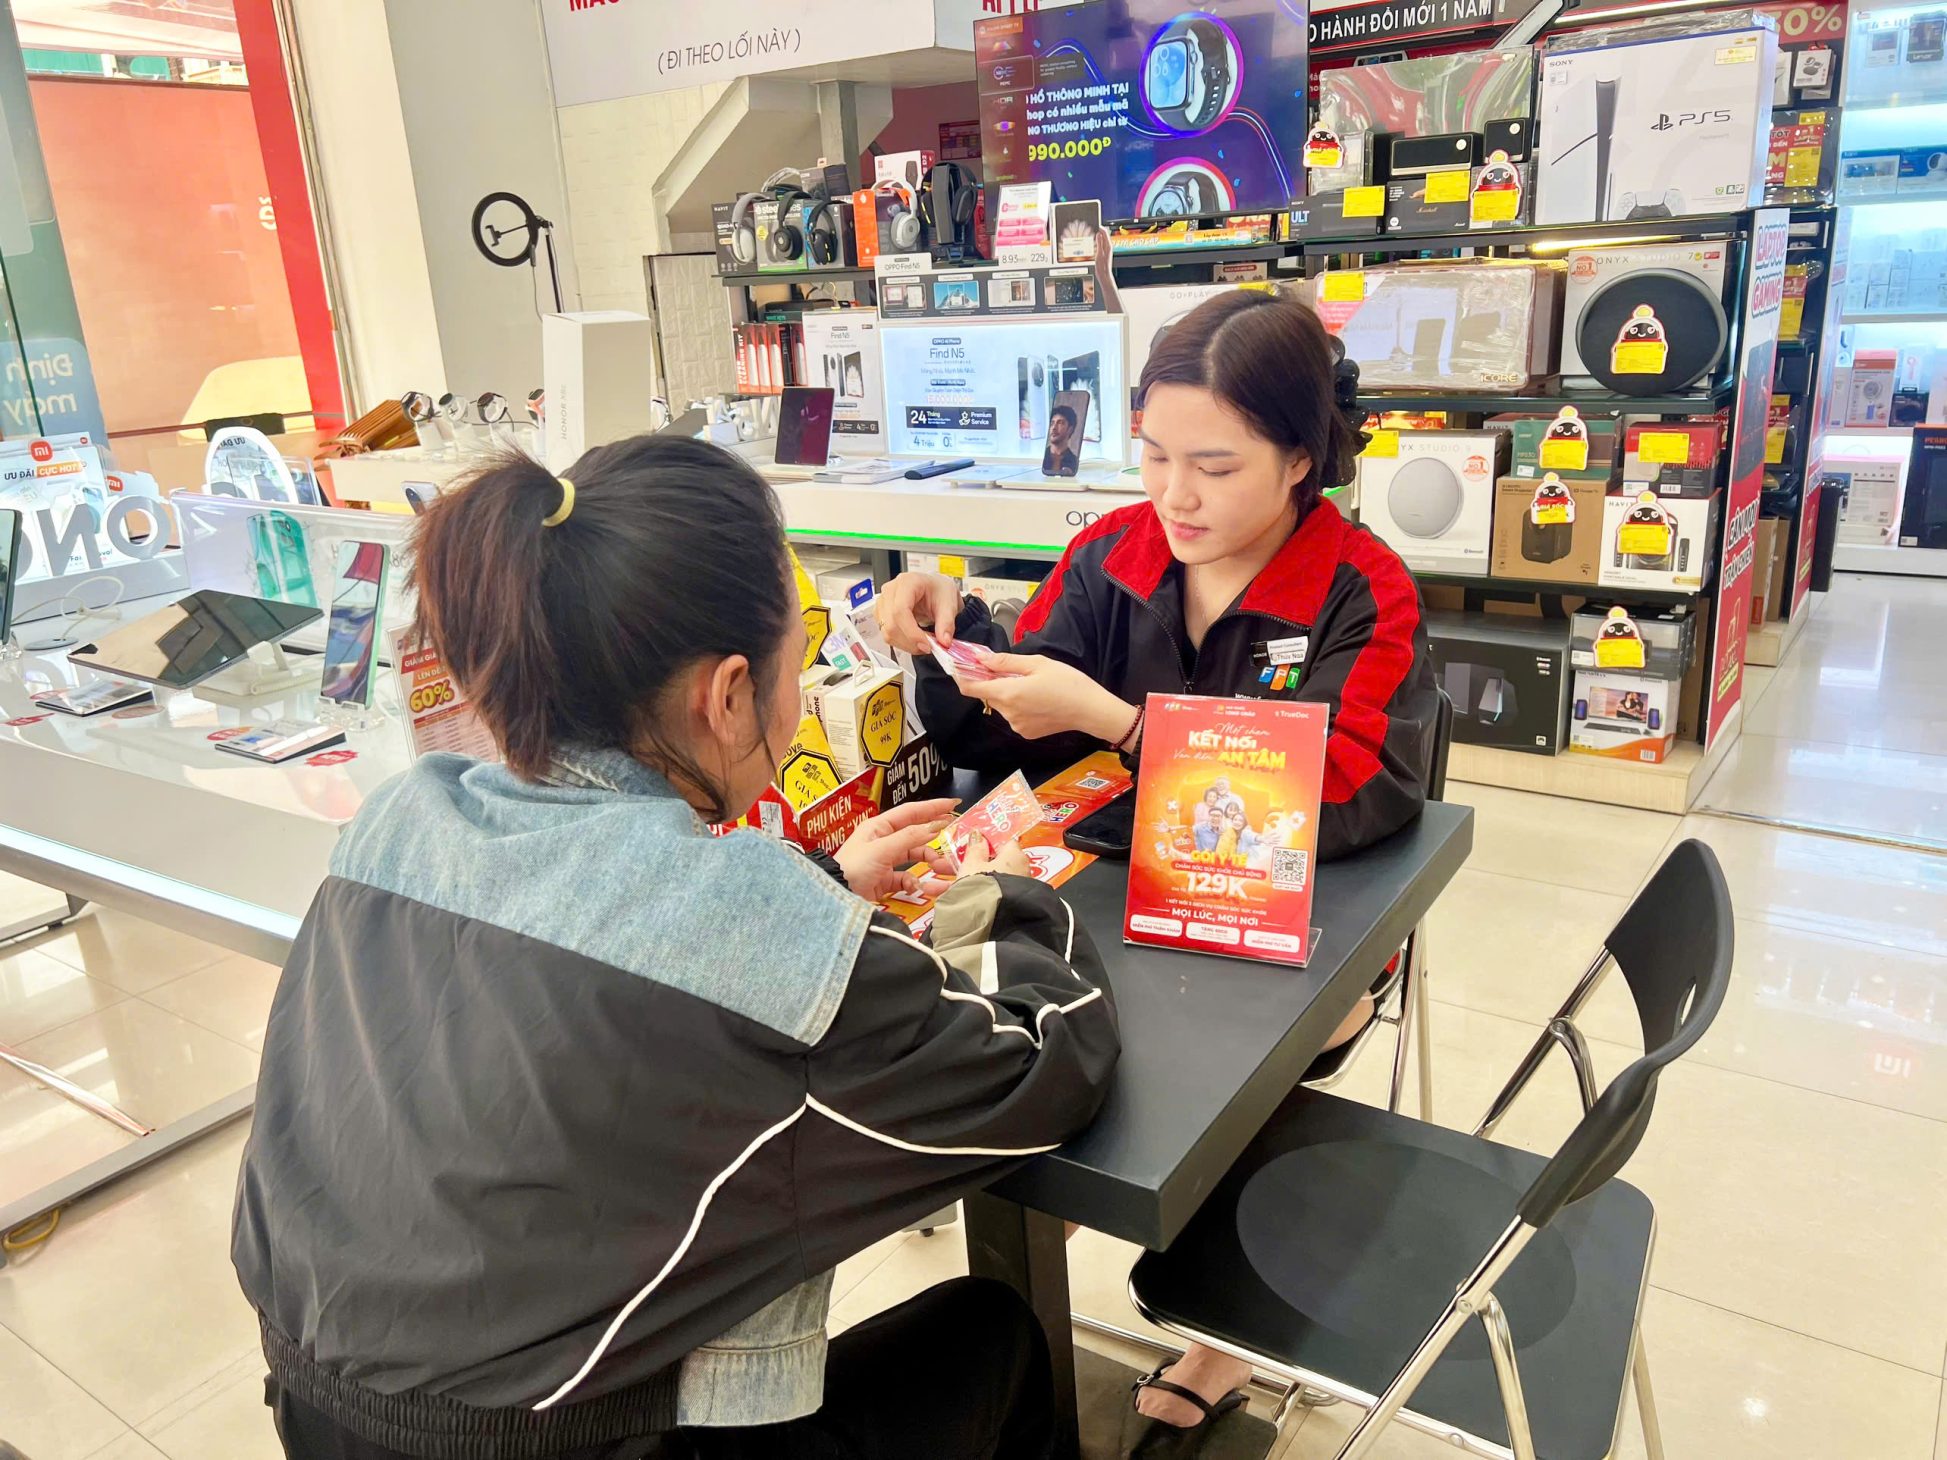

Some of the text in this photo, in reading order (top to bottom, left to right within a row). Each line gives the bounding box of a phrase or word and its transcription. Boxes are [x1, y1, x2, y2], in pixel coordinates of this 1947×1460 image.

[1321, 14, 1365, 41] HÀNH
[1370, 6, 1399, 33] ĐỔI
[1403, 0, 1435, 27] MỚI
[1440, 2, 1447, 21] 1
[686, 31, 752, 66] THEO LỐI
[1549, 59, 1573, 68] SONY
[1046, 87, 1082, 103] THÔNG
[1084, 86, 1110, 101] MINH
[1111, 82, 1129, 99] TẠI
[1046, 104, 1059, 118] có
[1061, 101, 1087, 117] nhiều
[1089, 100, 1111, 115] mẫu
[1113, 99, 1128, 112] mã
[1679, 109, 1732, 126] PS5
[1041, 121, 1079, 136] THƯƠNG
[1080, 119, 1102, 133] HIỆU
[1103, 117, 1116, 128] chỉ
[1291, 210, 1310, 224] ULT
[1597, 256, 1629, 265] ONYX
[929, 347, 964, 359] Find N5
[1480, 372, 1518, 383] iCORE
[910, 409, 927, 424] 24
[971, 411, 992, 419] Premium
[4, 466, 57, 480] ƯU ĐÃI CỰC
[411, 680, 454, 712] 60%
[1280, 710, 1310, 719] TrueDoc
[1188, 728, 1222, 749] KẾT
[1217, 747, 1287, 769] AN TÂM
[887, 761, 905, 786] GIẢM
[892, 781, 907, 805] ĐẾN
[807, 794, 852, 839] PHỤ KIỆN
[986, 801, 1012, 833] HERO
[1049, 802, 1078, 823] HERO
[1187, 871, 1248, 900] 129K
[1172, 908, 1258, 926] MỌI LÚC, MỌI NƠI
